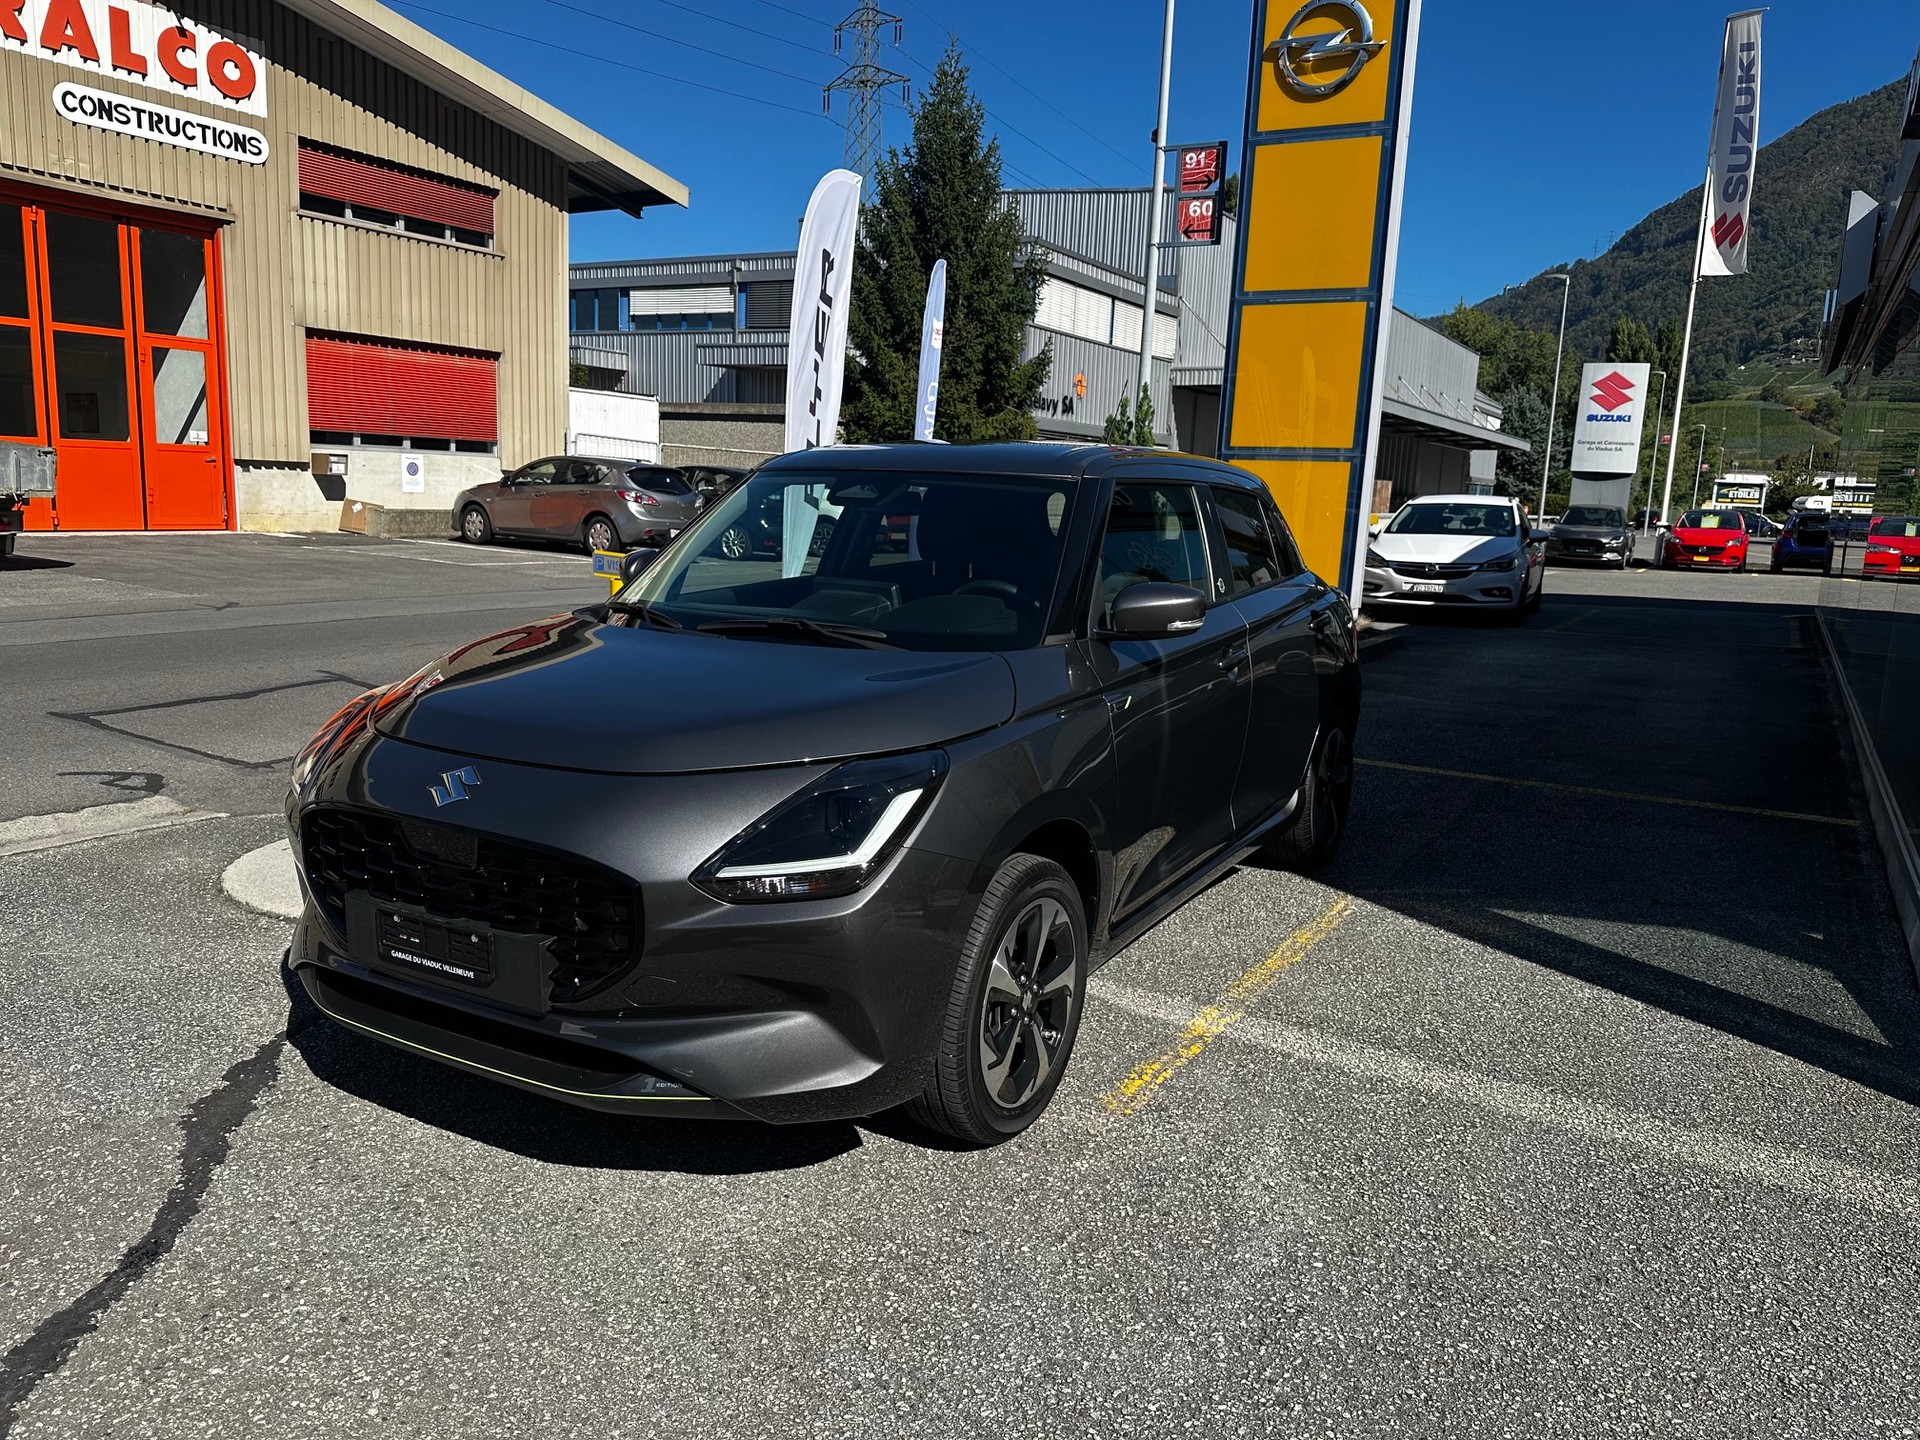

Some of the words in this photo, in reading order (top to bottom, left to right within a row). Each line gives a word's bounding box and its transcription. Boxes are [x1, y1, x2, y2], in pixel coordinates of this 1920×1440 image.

[61, 90, 262, 156] CONSTRUCTIONS
[1722, 41, 1756, 203] SUZUKI
[1185, 151, 1206, 169] 91
[1188, 200, 1213, 217] 60
[1033, 391, 1059, 417] elavy
[1061, 395, 1074, 415] SA
[1586, 414, 1632, 423] SUZUKI
[391, 950, 412, 961] GARAGE
[413, 956, 421, 964] DU
[422, 958, 442, 970] VIADUC
[443, 964, 474, 979] VILLENEUVE
